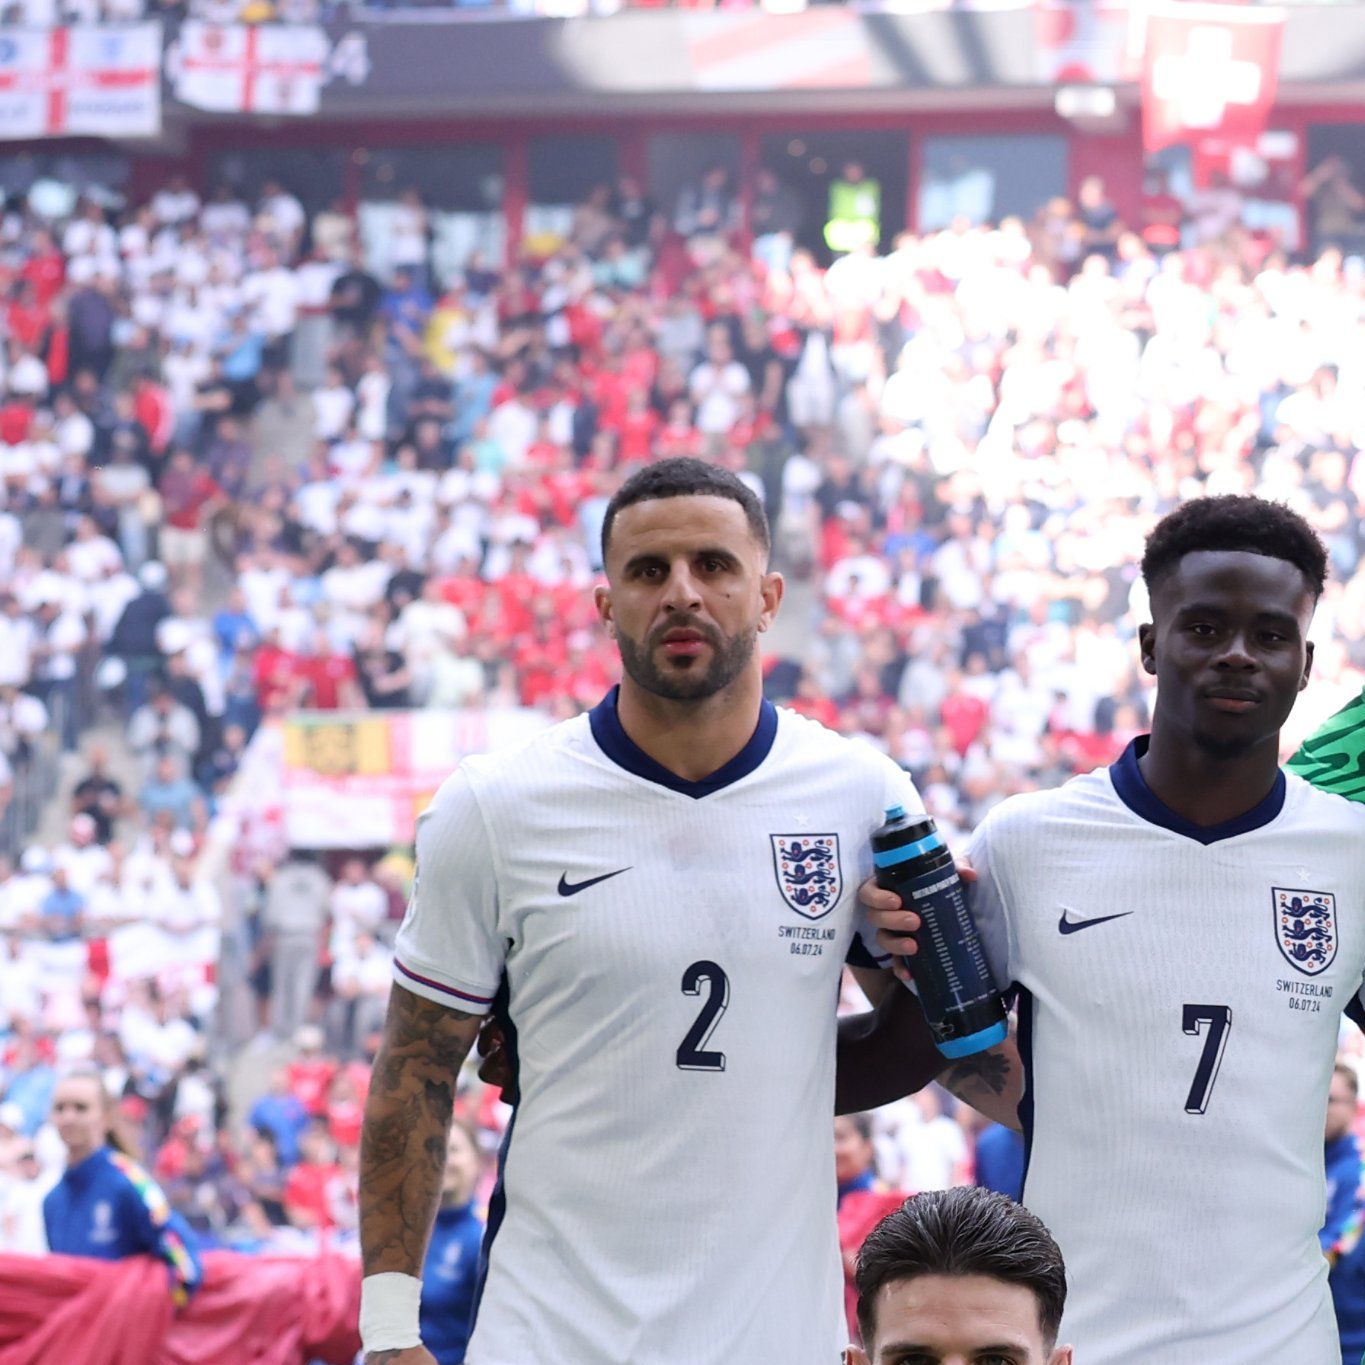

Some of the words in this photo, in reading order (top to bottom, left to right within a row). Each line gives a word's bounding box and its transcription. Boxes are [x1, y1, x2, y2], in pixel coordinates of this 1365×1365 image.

[778, 925, 836, 940] SWITZERLAND
[790, 942, 822, 955] 06.07.24
[1276, 979, 1333, 997] SWITZERLAND
[1289, 997, 1320, 1012] 06.07.24
[676, 960, 730, 1071] 2
[1182, 1004, 1232, 1114] 7
